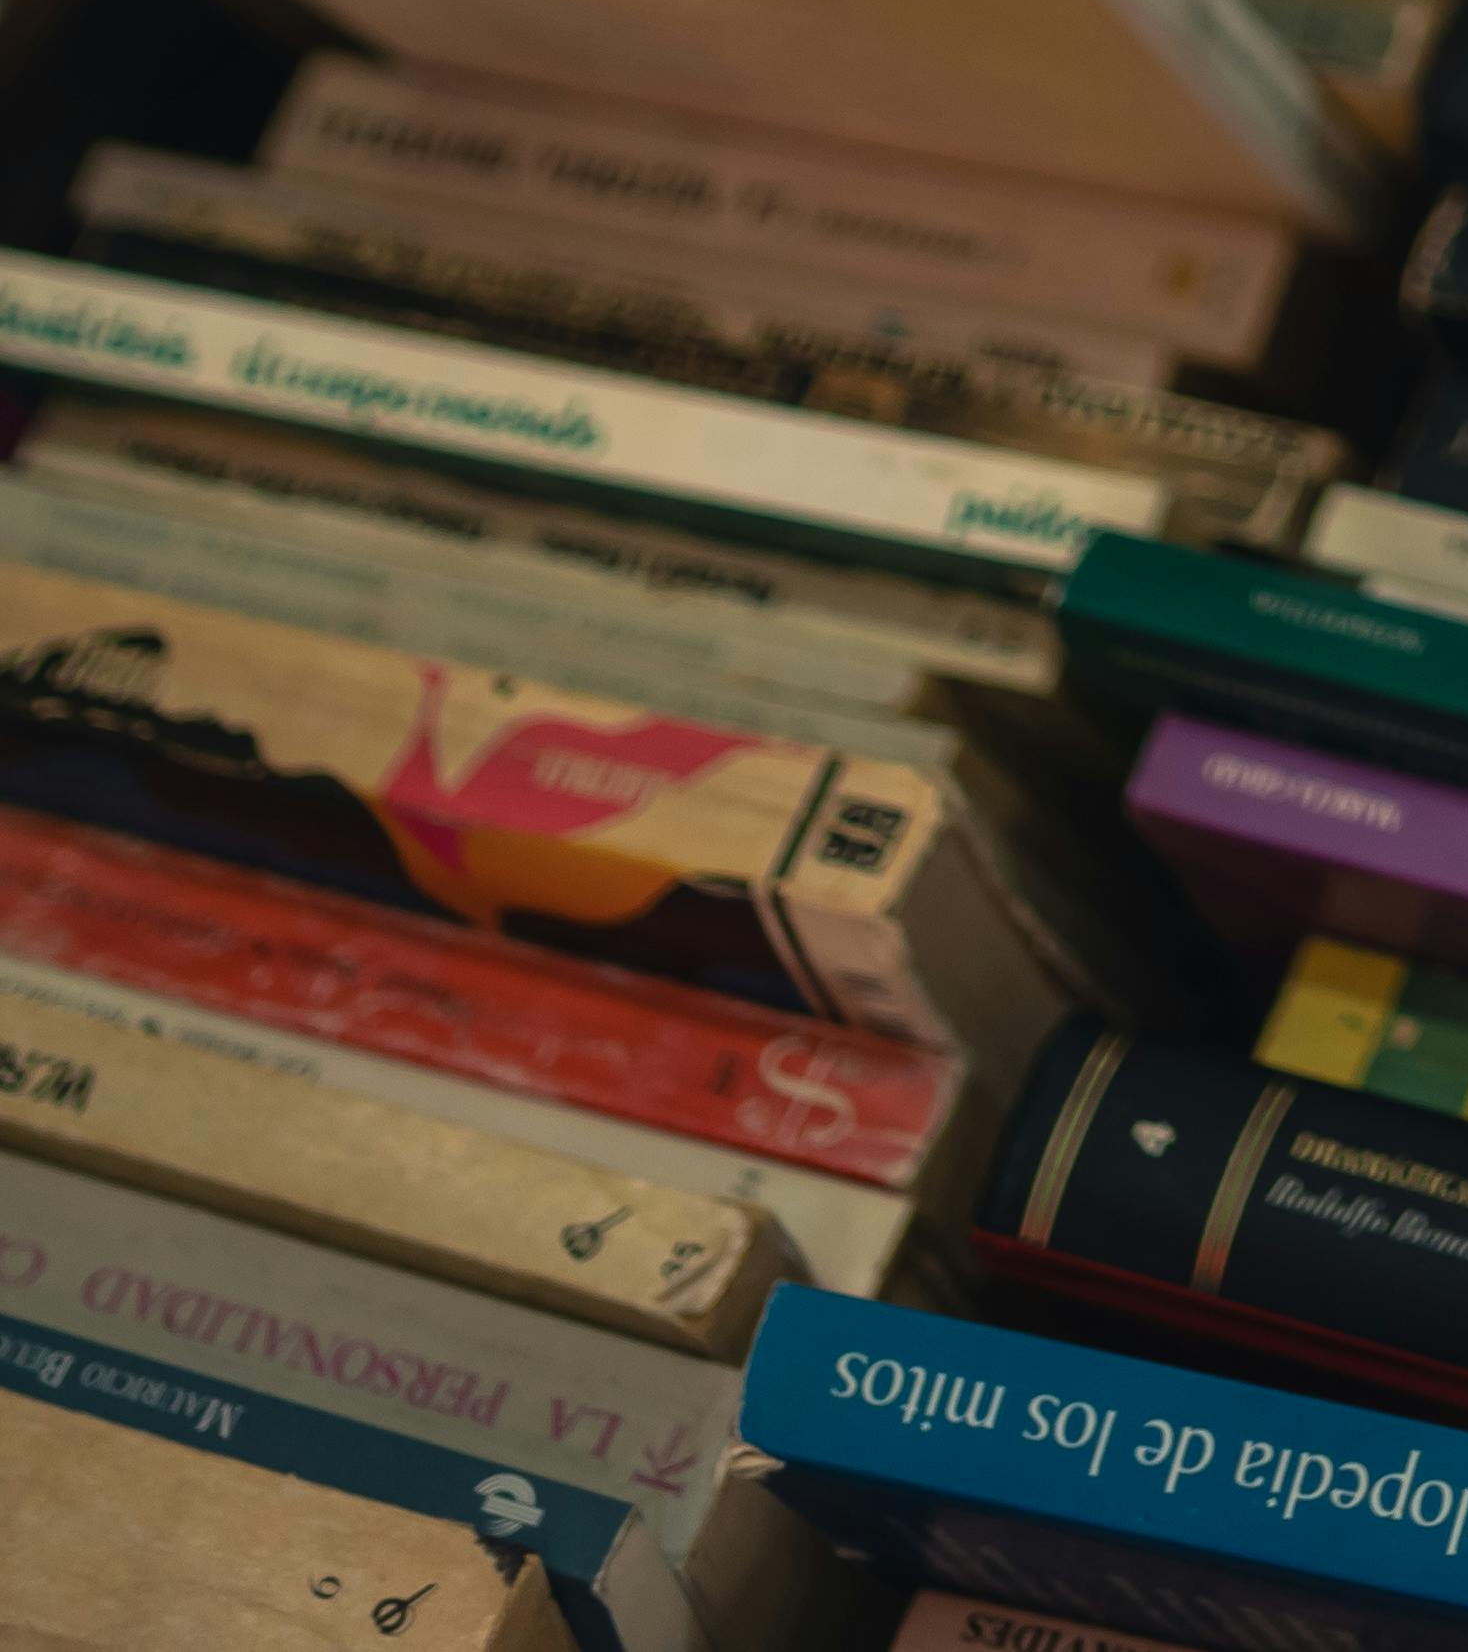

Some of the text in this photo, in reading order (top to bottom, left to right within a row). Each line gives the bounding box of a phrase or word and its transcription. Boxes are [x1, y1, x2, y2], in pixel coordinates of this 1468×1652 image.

[77, 1260, 510, 1429] PERSONALIDAD
[543, 1391, 623, 1459] LA
[827, 1348, 1006, 1443] mitos
[1017, 1388, 1118, 1476] los
[1130, 1410, 1218, 1501] de
